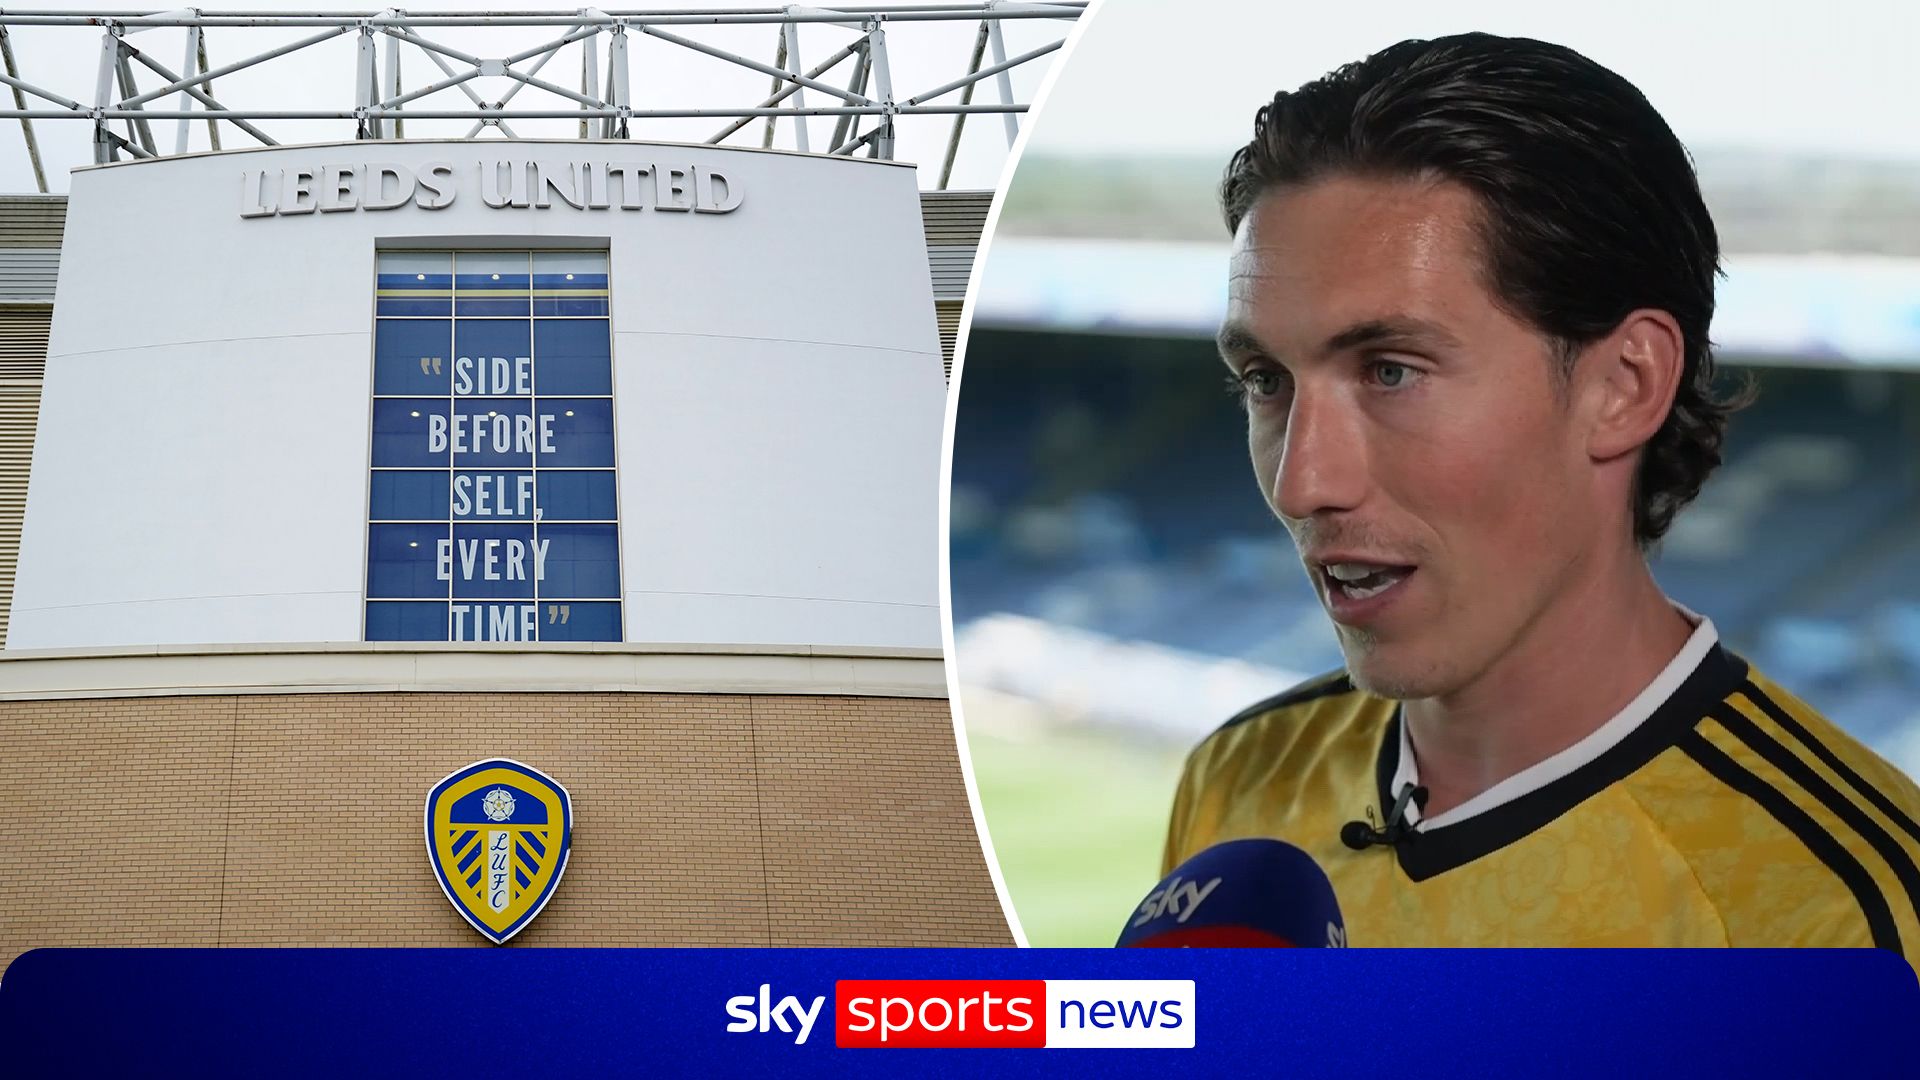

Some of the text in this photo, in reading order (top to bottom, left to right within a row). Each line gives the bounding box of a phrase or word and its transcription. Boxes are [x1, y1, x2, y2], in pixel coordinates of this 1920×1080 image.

[240, 160, 745, 219] LEEDS UNITED
[428, 414, 556, 453] BEFORE
[453, 475, 543, 521] SELF,
[436, 539, 550, 580] EVERY
[490, 832, 508, 908] LUFC
[1134, 876, 1222, 928] sky
